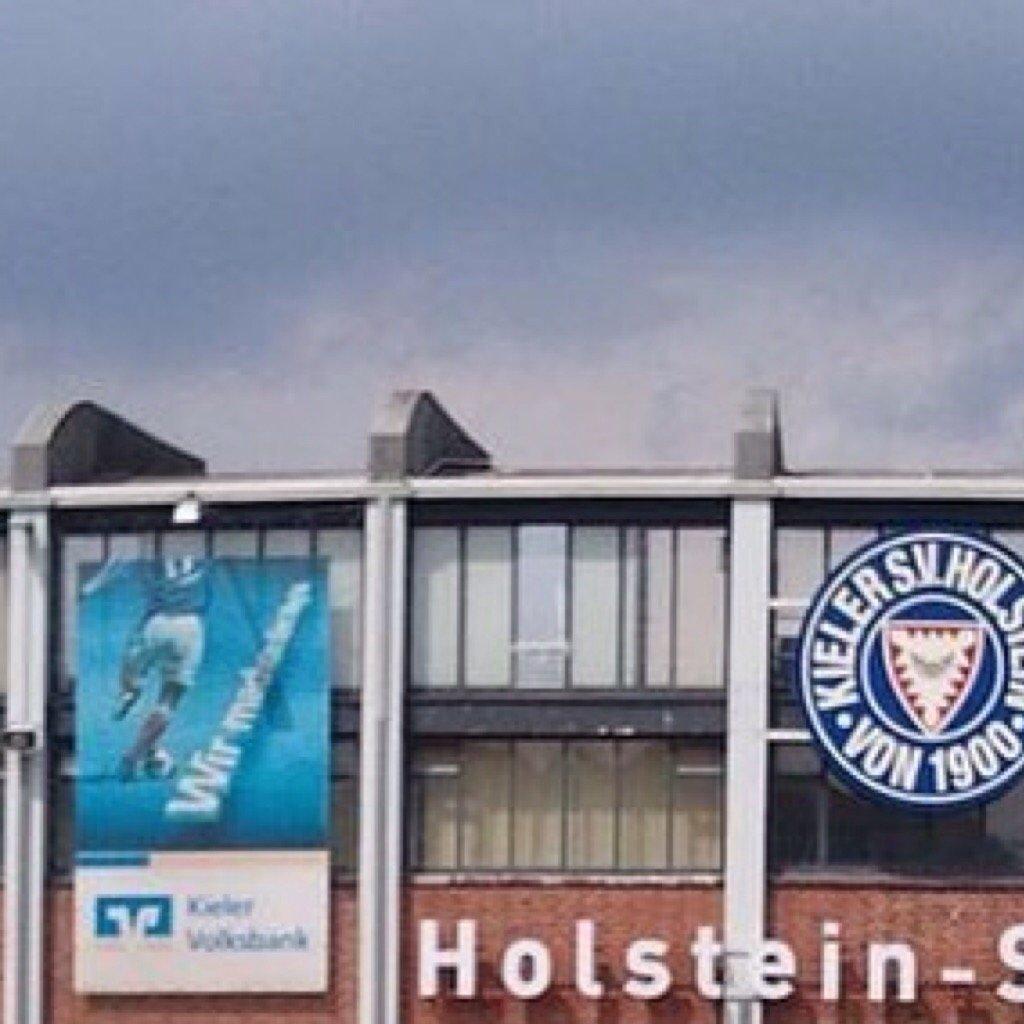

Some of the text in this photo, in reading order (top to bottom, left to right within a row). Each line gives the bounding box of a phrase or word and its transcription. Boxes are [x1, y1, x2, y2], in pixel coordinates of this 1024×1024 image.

[812, 567, 894, 711] KIELER
[845, 716, 1023, 792] VON 1900
